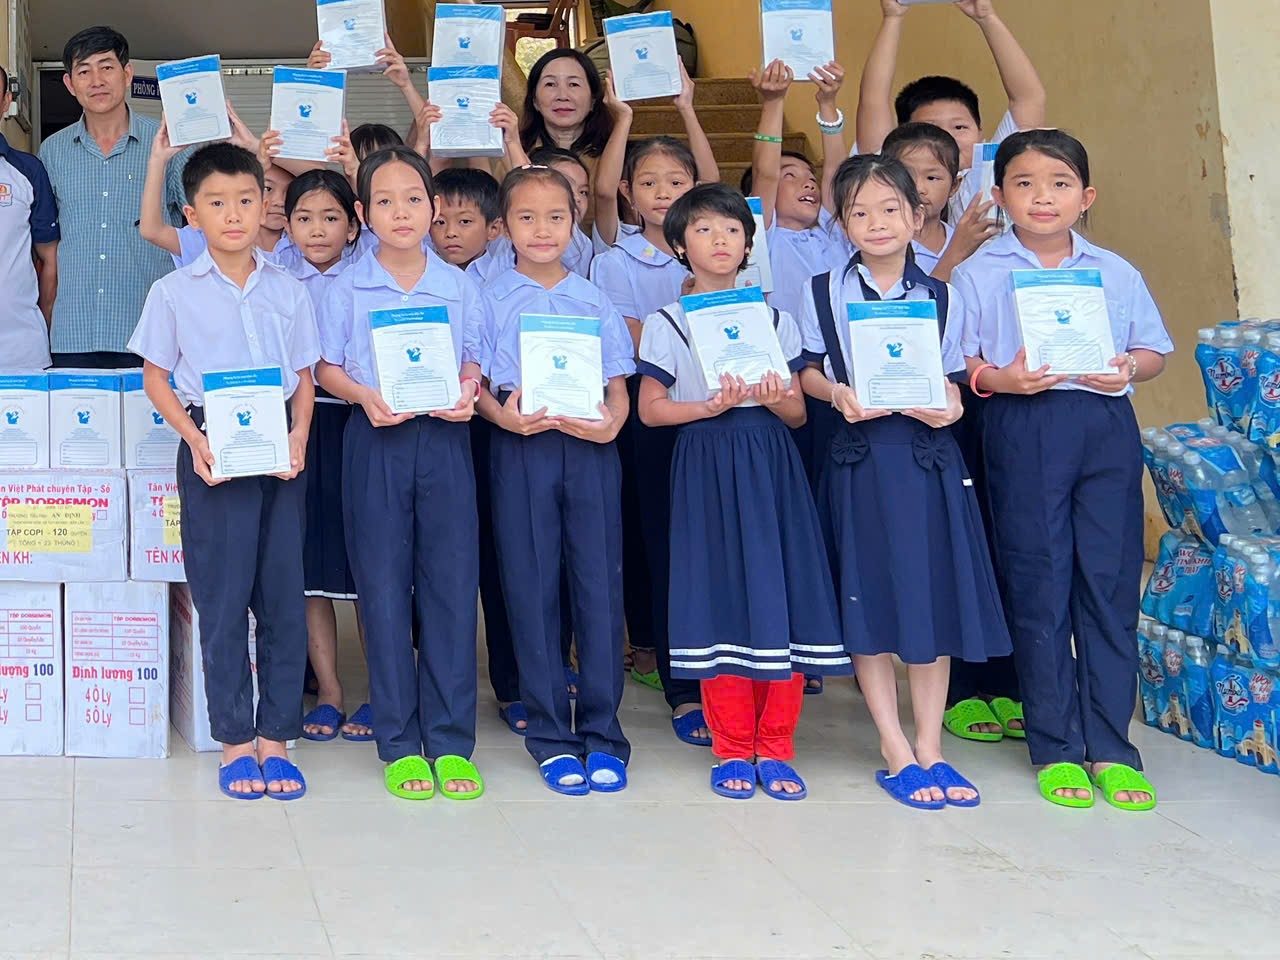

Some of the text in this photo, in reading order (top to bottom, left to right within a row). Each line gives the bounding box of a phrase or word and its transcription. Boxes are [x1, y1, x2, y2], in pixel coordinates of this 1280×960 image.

[133, 80, 156, 96] PHÒNG
[8, 484, 24, 493] Việt
[26, 484, 45, 493] Phát
[47, 484, 75, 494] chuyên
[77, 484, 92, 494] Tập
[100, 483, 111, 493] Số
[148, 483, 178, 492] Tân Việ
[24, 528, 44, 536] COPI
[53, 528, 68, 536] 120
[13, 551, 33, 564] KH:
[145, 547, 169, 563] TÊN
[33, 663, 54, 676] 100
[72, 666, 158, 682] Định lượng 100
[86, 684, 111, 706] 4 Ô Ly
[0, 706, 9, 725] Ly
[86, 705, 112, 727] 5 Ô Ly
